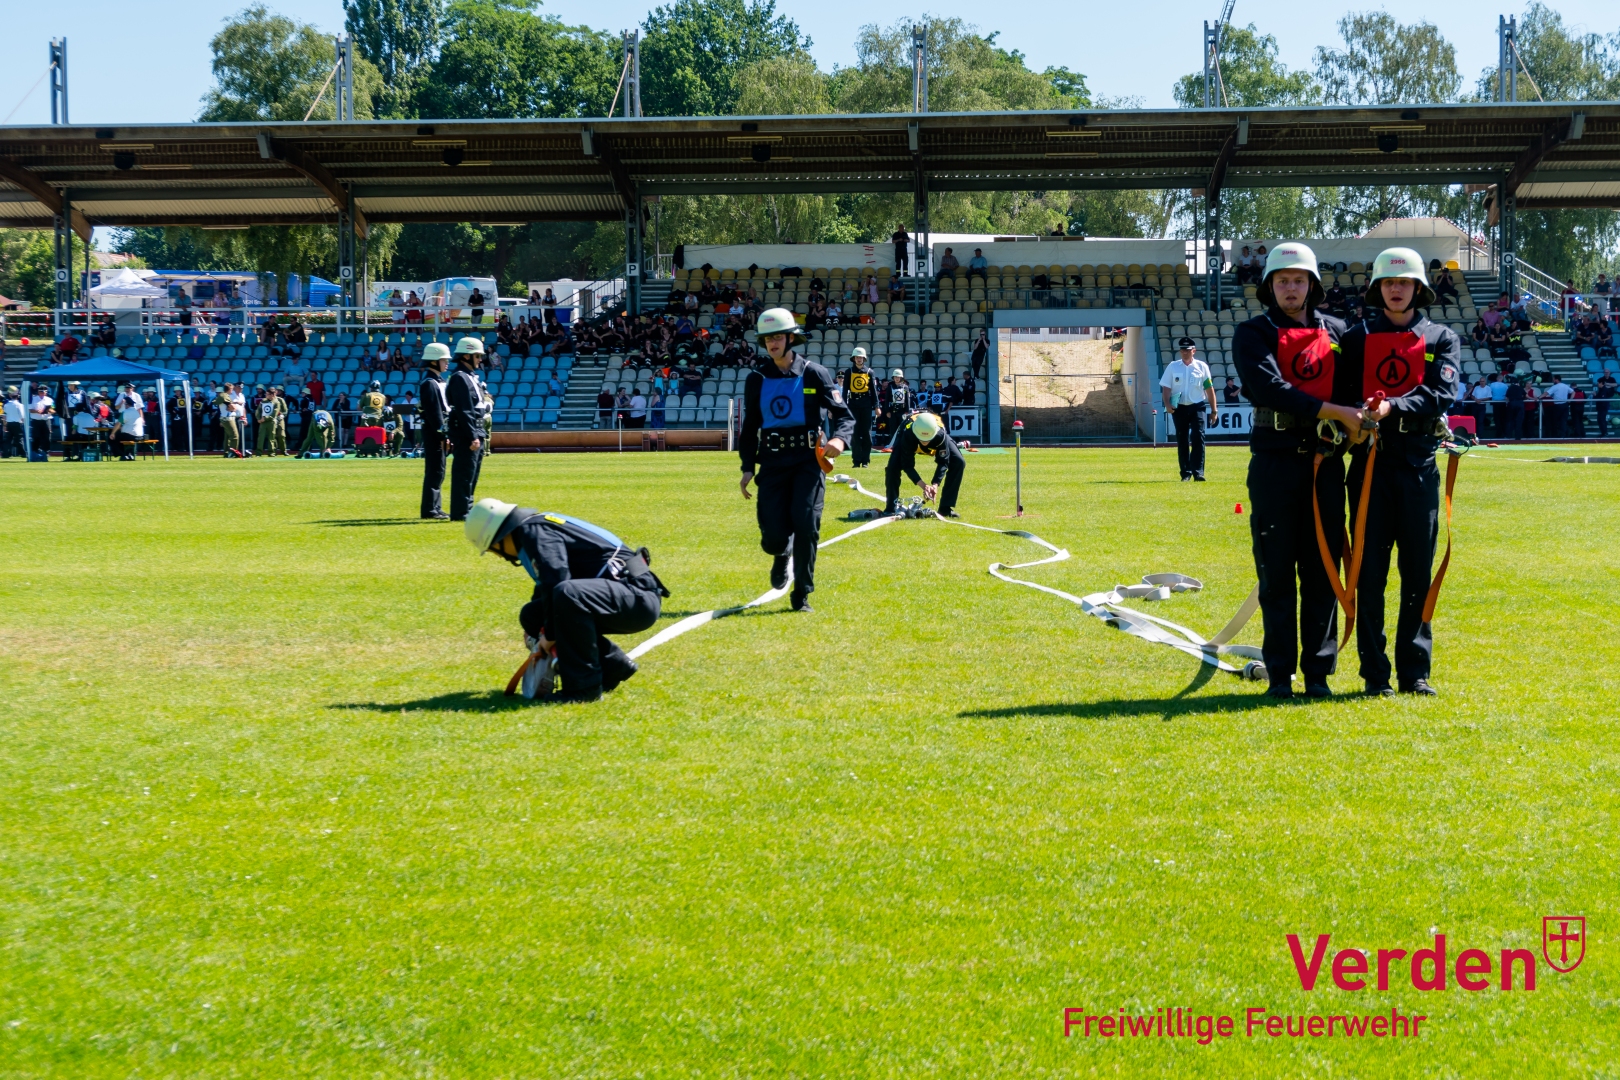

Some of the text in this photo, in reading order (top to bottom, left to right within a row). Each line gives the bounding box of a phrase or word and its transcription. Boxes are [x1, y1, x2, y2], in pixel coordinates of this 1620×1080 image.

[1209, 257, 1218, 268] Q
[1504, 253, 1513, 265] Q
[629, 264, 637, 275] P
[918, 261, 926, 271] P
[1386, 361, 1399, 382] A
[856, 378, 863, 387] S
[950, 415, 975, 431] DT
[1206, 412, 1242, 429] DEN
